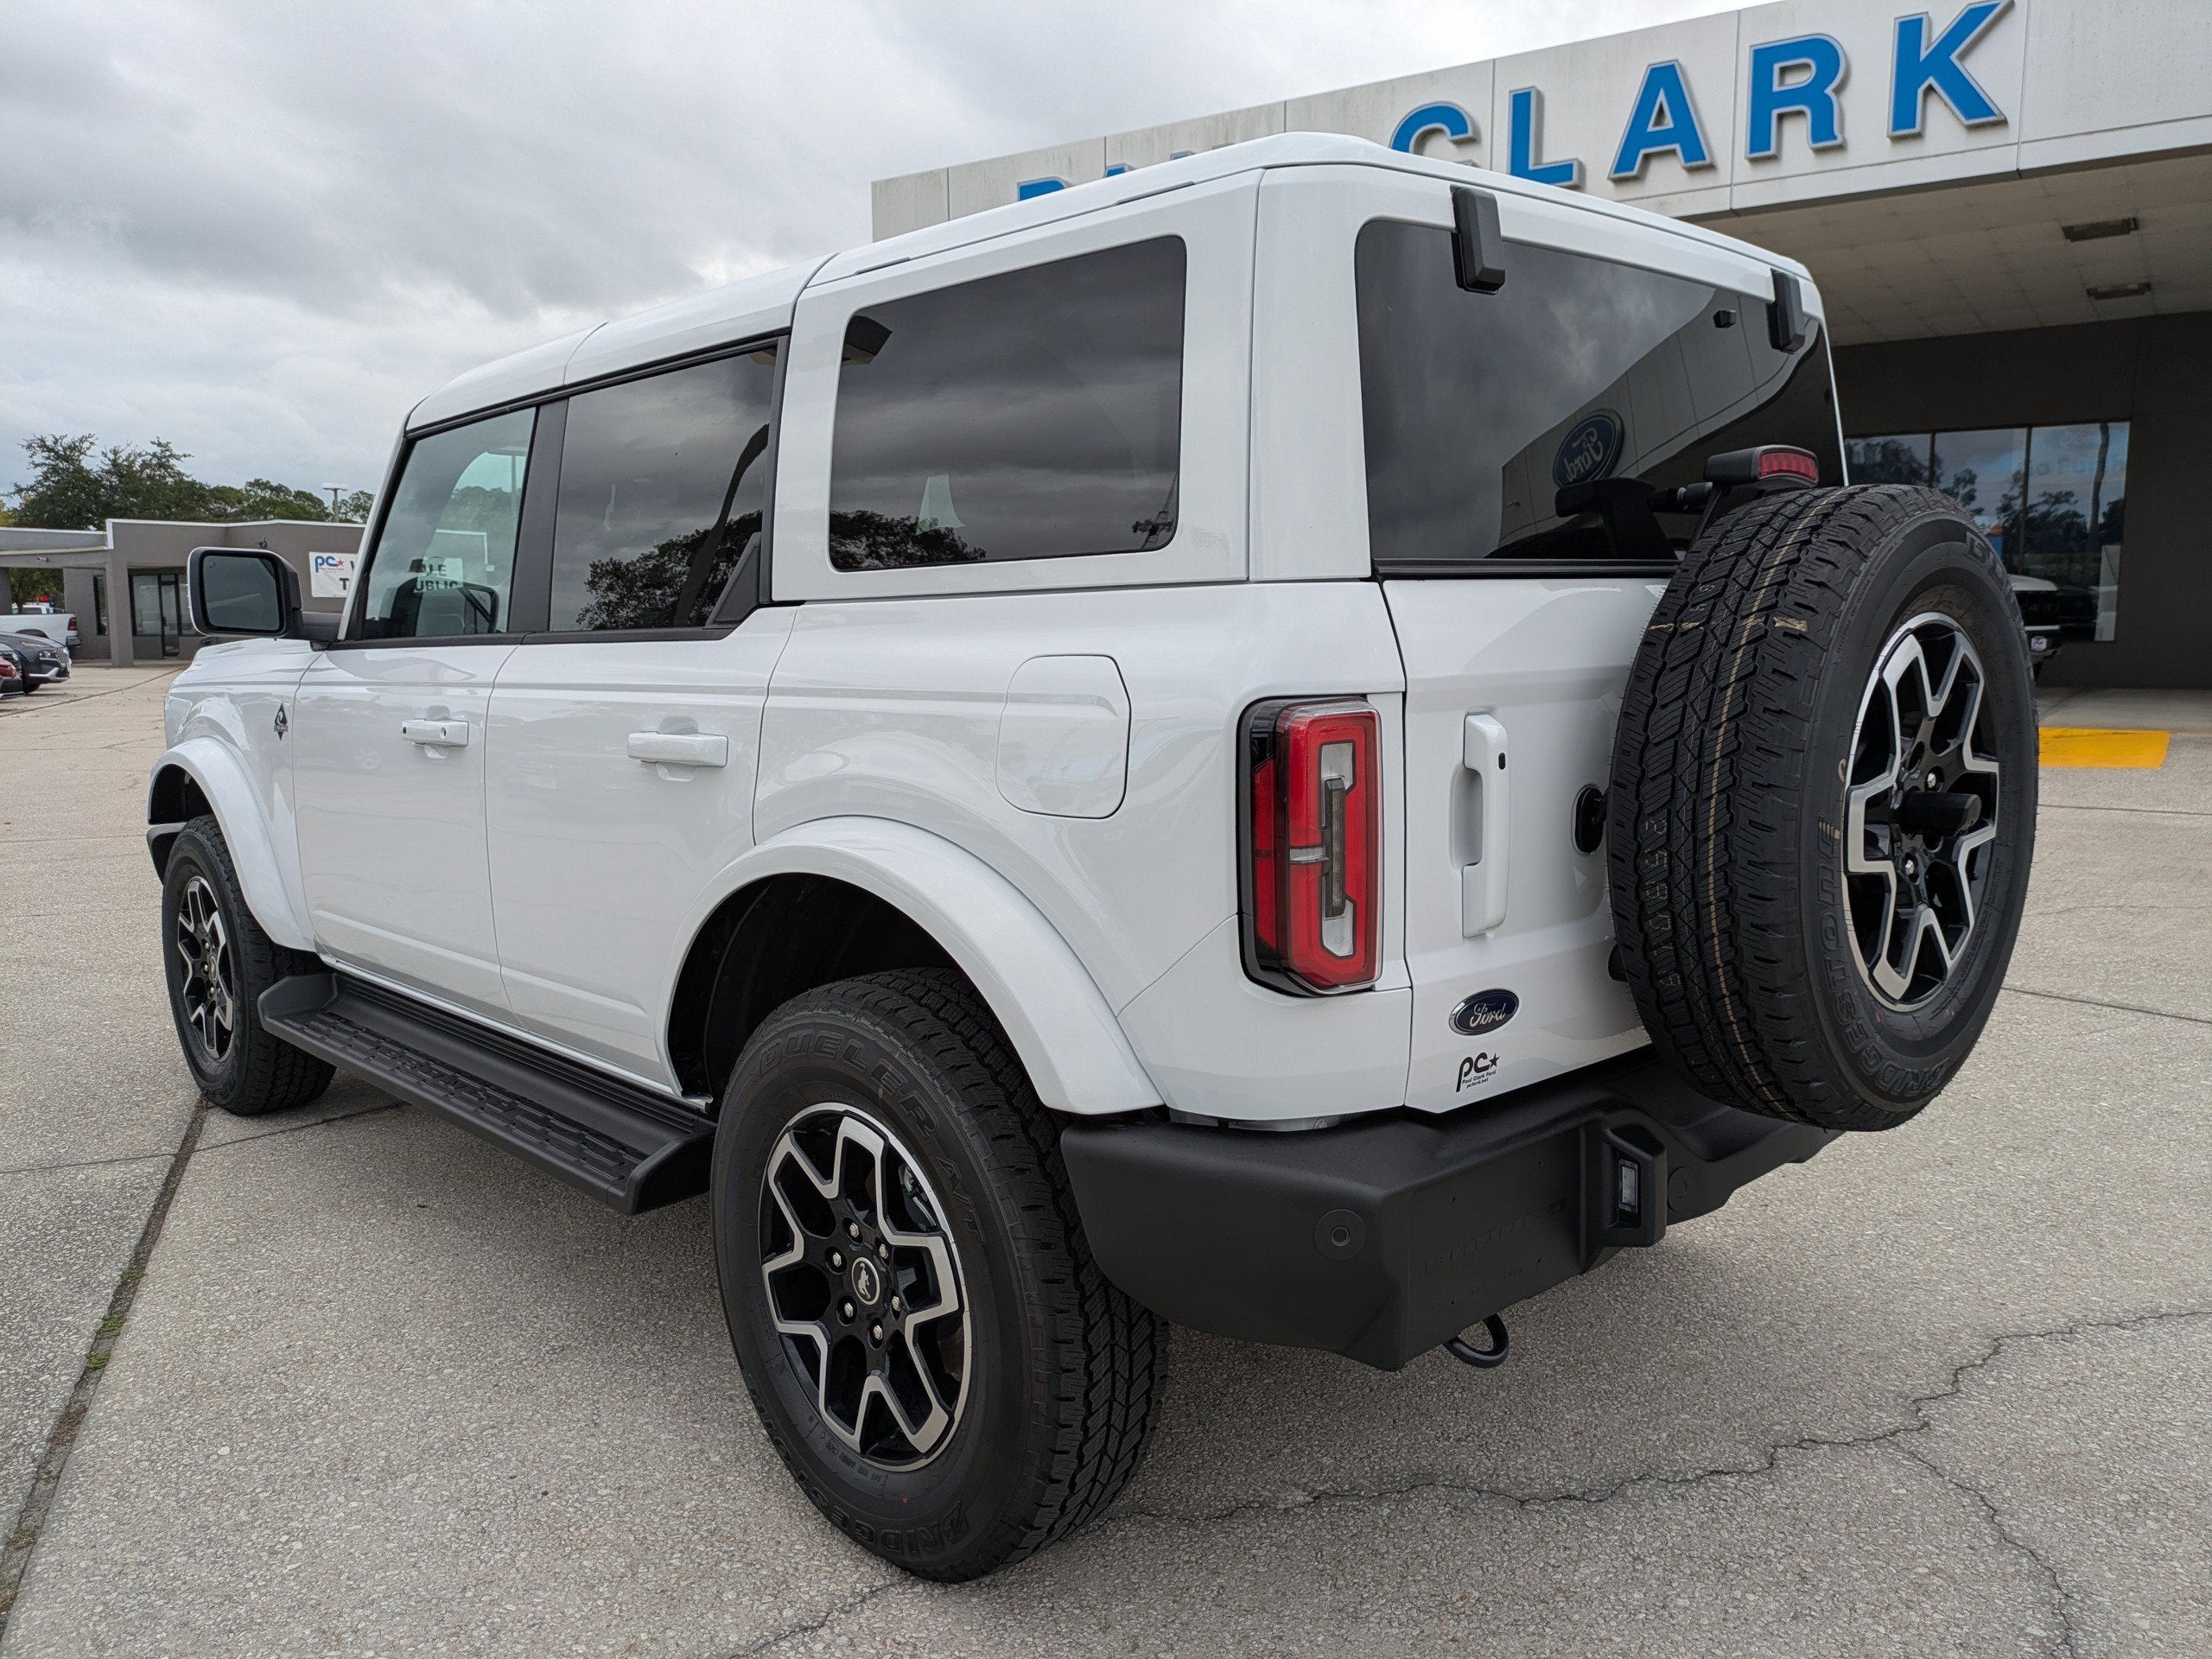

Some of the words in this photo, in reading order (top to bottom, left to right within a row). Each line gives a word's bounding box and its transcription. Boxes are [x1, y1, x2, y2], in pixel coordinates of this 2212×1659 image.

[1389, 0, 2013, 188] CLARK
[1469, 1002, 1507, 1027] Ford
[759, 1029, 939, 1138] DUELER
[1472, 1073, 1485, 1082] Clark
